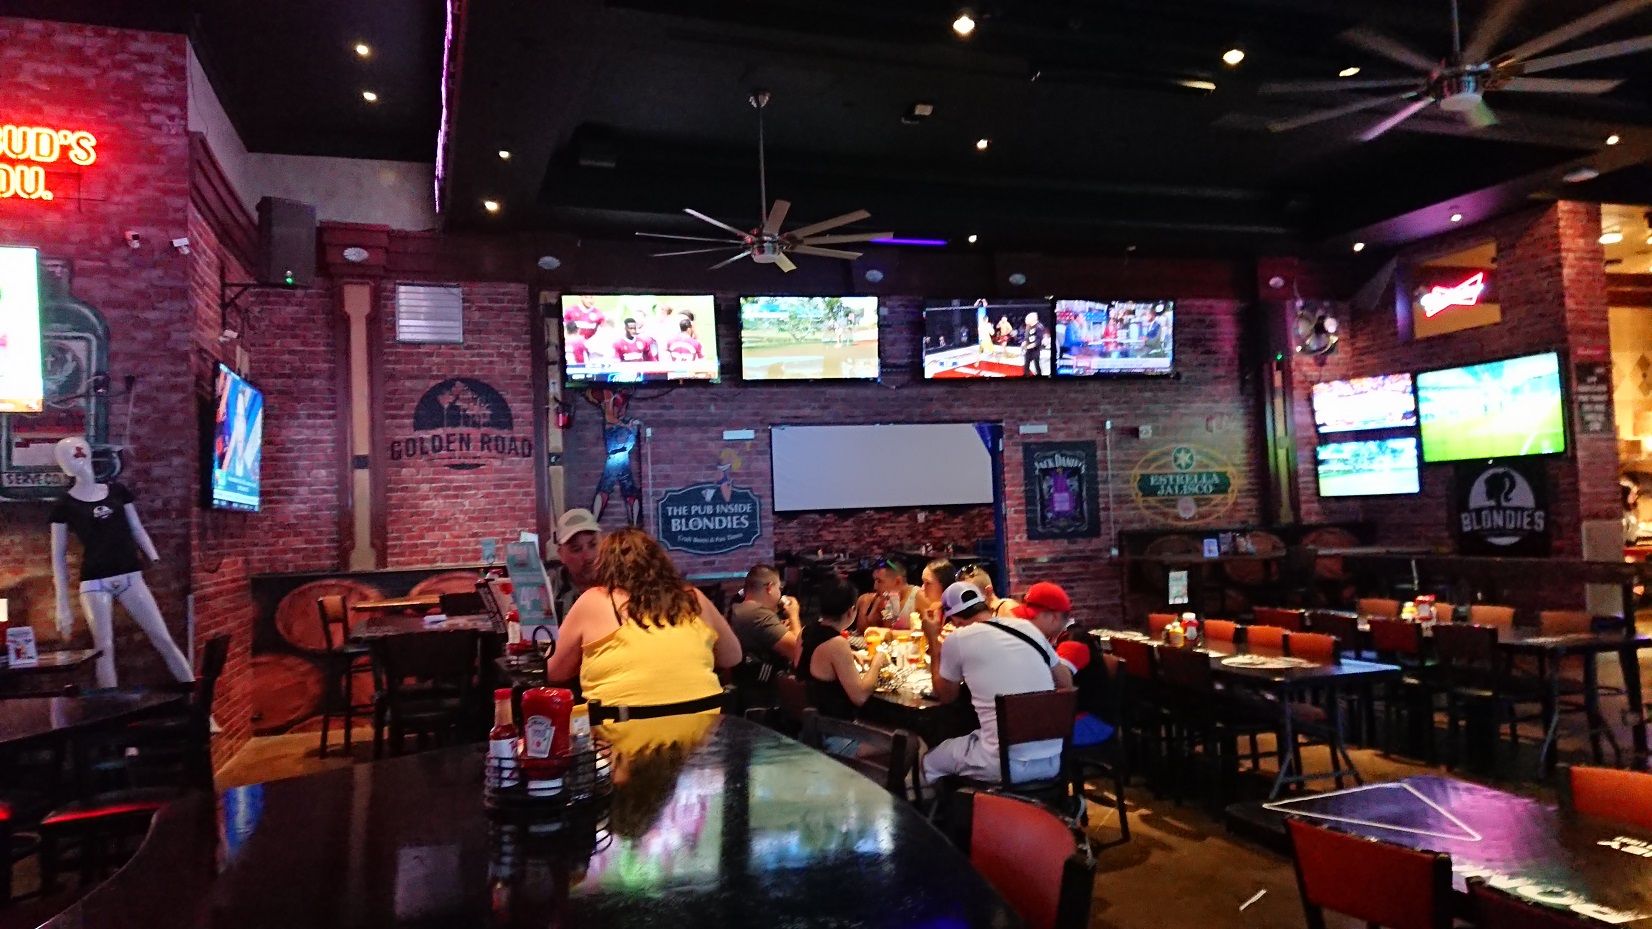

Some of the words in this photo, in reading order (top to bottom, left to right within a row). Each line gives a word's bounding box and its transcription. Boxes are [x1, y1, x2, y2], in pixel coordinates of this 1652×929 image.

[0, 124, 97, 166] UD'S
[390, 433, 470, 461] GOLDEN
[480, 433, 533, 458] ROAD
[1150, 473, 1220, 486] ESTRELLA
[1157, 484, 1214, 496] JALISCO
[666, 506, 689, 517] THE
[690, 504, 714, 515] PUB
[716, 503, 753, 514] INSIDE
[671, 515, 749, 532] BLONDIES
[1460, 509, 1546, 533] BLONDIES
